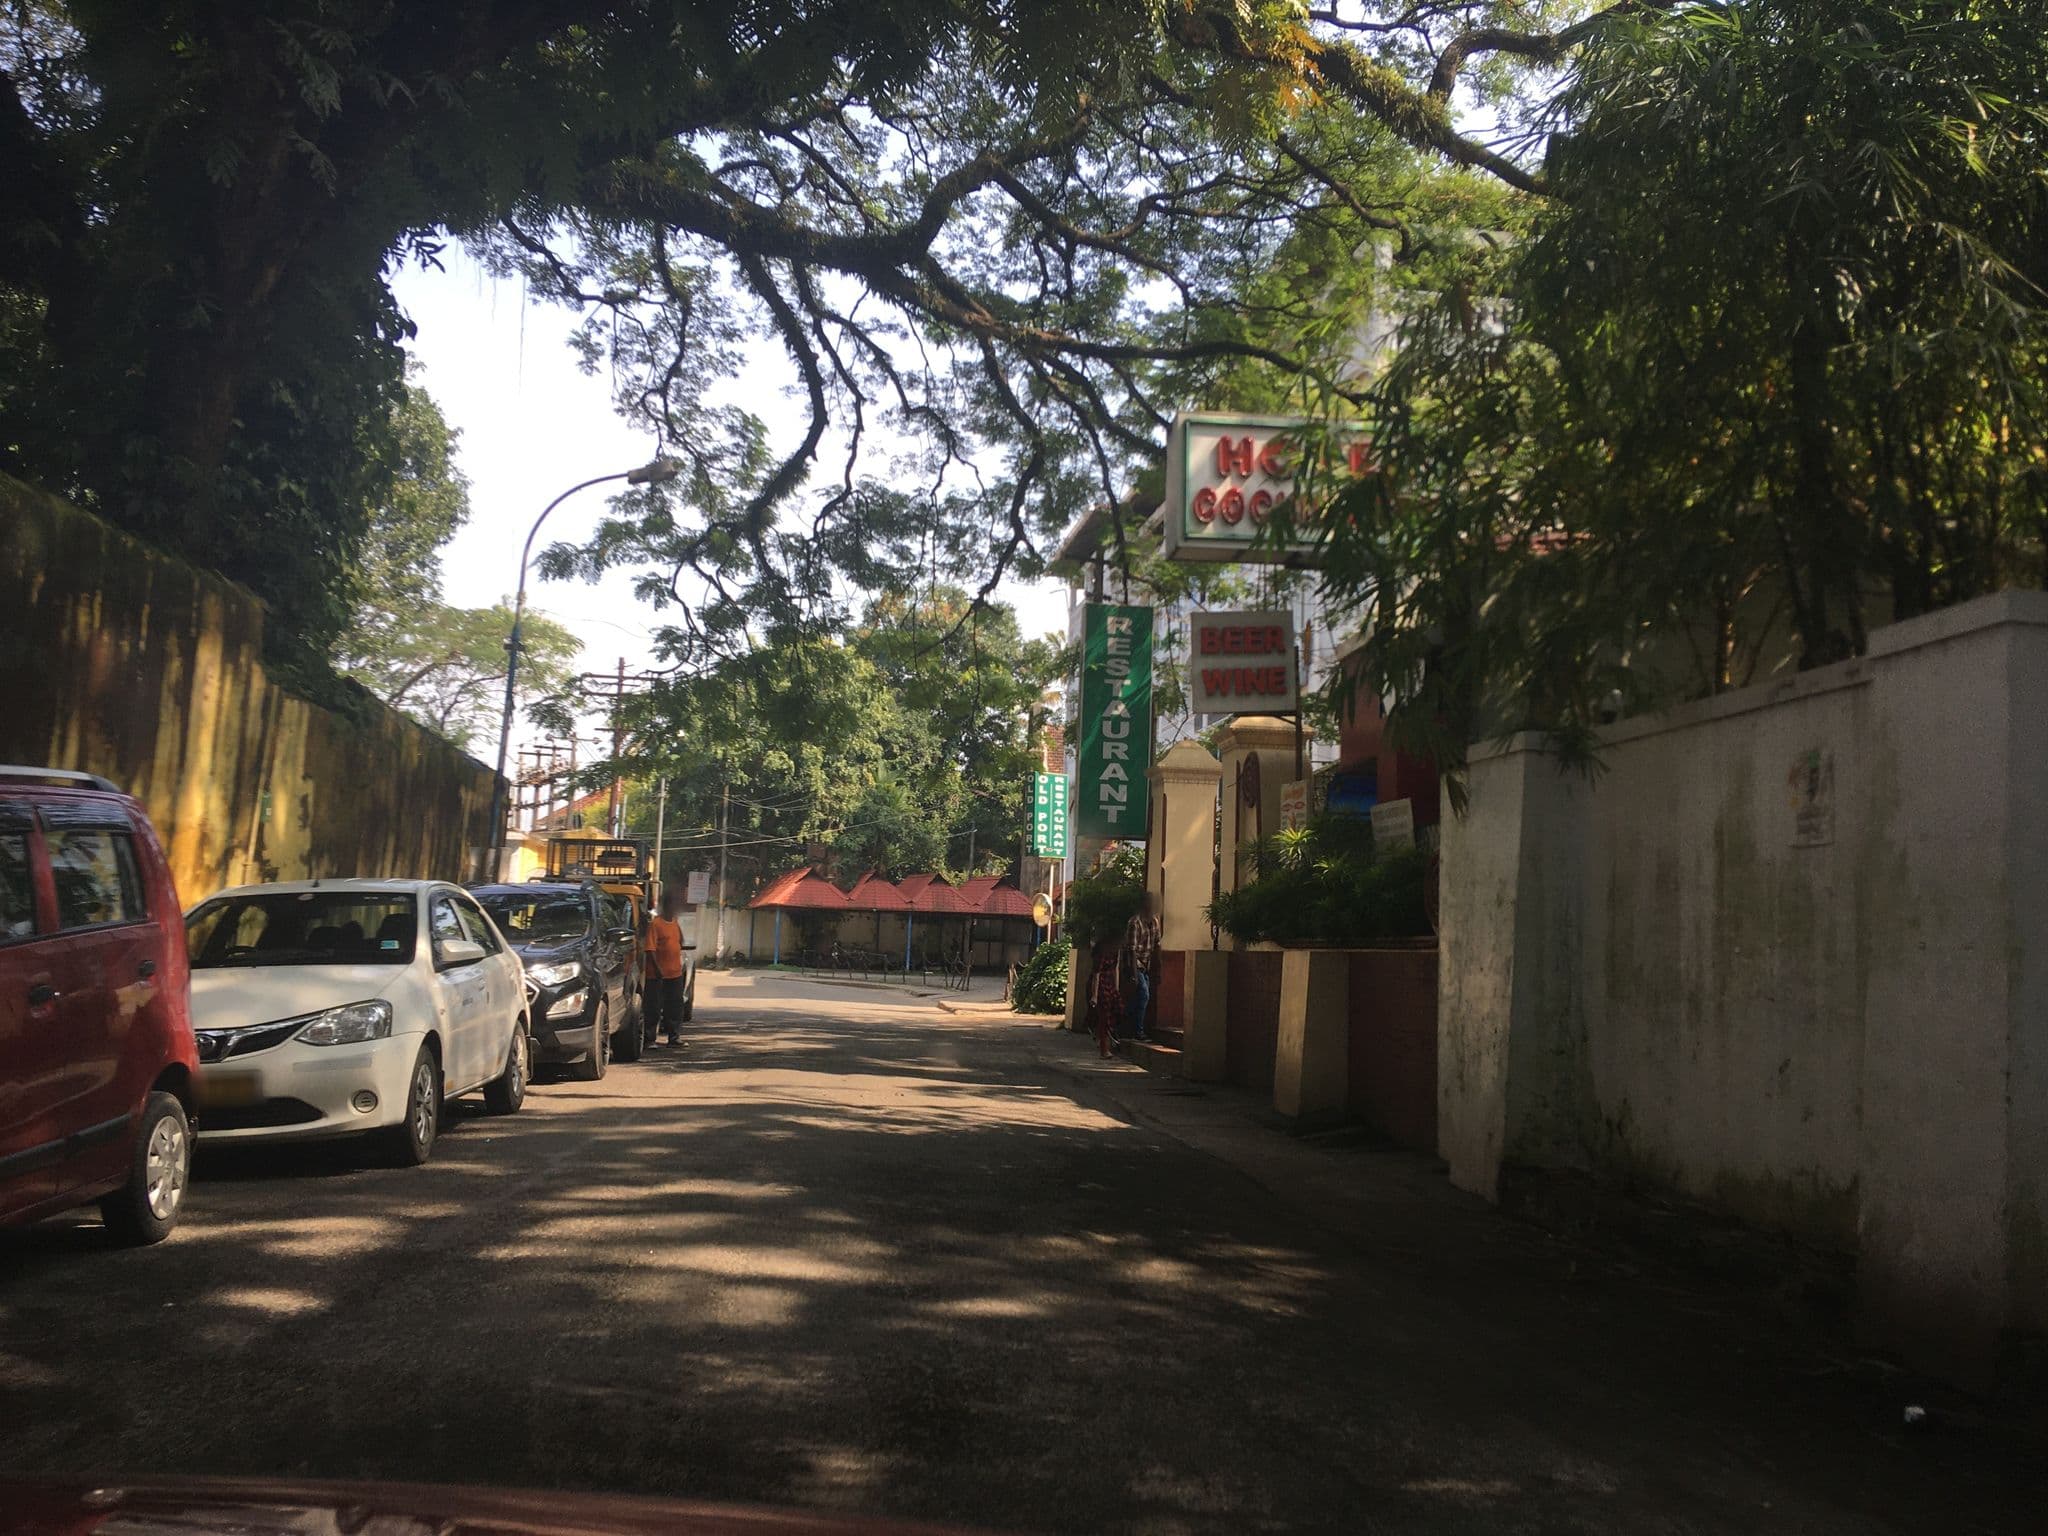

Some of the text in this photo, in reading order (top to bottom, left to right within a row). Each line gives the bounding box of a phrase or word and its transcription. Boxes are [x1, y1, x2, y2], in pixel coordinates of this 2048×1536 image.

[1200, 624, 1286, 656] BEER
[1201, 666, 1287, 697] WINE
[1099, 615, 1133, 824] RESTAURANT
[1025, 812, 1034, 854] PORT
[1037, 775, 1048, 854] OLD PORT
[1053, 776, 1064, 855] RESTAURANT
